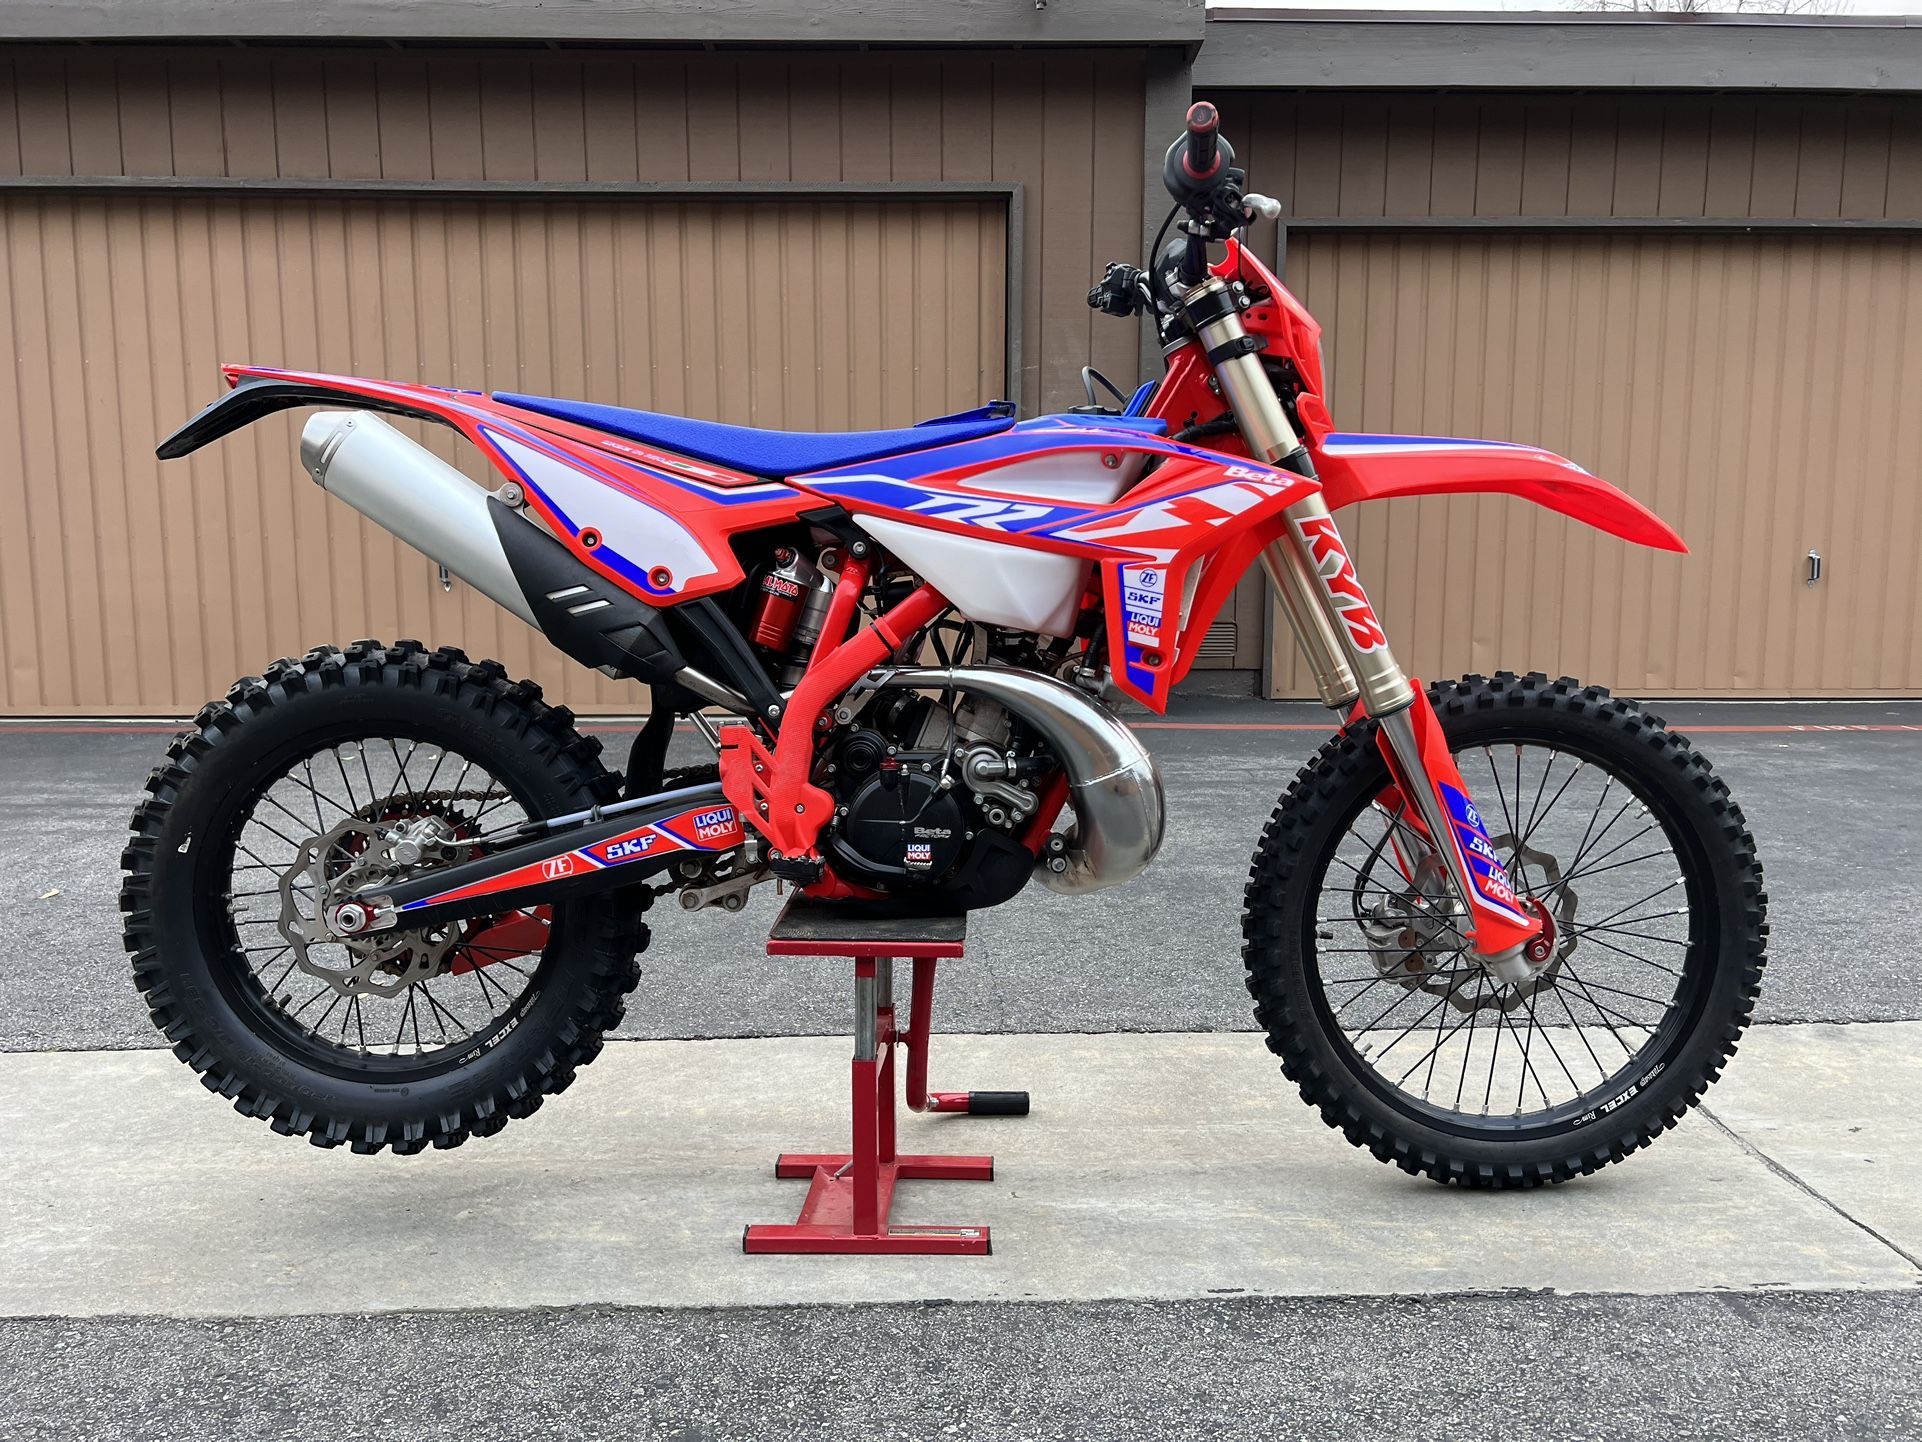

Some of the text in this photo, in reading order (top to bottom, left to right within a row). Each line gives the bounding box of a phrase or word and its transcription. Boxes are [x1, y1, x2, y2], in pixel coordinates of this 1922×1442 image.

[1223, 465, 1296, 488] Beta
[1141, 571, 1157, 584] ZF
[1294, 514, 1388, 654] KYB
[1128, 592, 1161, 605] SKF
[1131, 612, 1160, 627] LIQUI
[1128, 622, 1159, 636] MOLY
[694, 808, 732, 827] LIQUI
[699, 823, 735, 840] MOLY
[914, 827, 952, 835] Beta
[606, 833, 657, 860] SKF
[907, 844, 931, 852] LIQUI
[907, 852, 931, 860] MOLY
[548, 858, 570, 878] ZF
[484, 1017, 519, 1048] EXCEL
[1600, 1085, 1639, 1113] EXCEL
